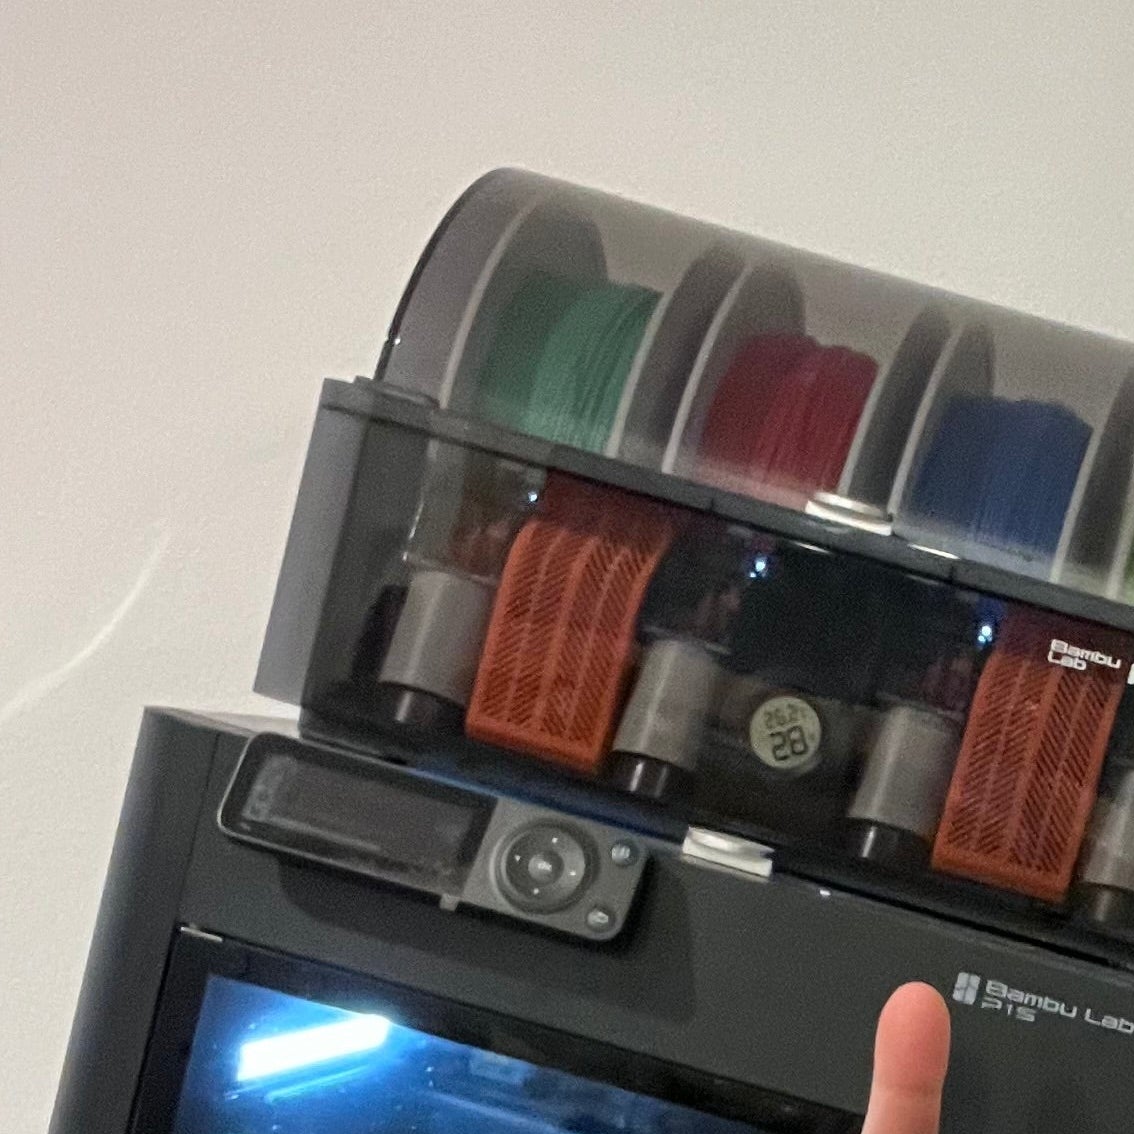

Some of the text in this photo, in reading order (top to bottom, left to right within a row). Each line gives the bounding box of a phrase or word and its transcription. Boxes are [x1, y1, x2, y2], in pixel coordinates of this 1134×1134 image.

[1047, 650, 1087, 671] Lab
[1050, 639, 1121, 669] Bambu
[769, 725, 809, 761] 28
[981, 996, 1037, 1023] P1S
[986, 980, 1078, 1019] Bambu
